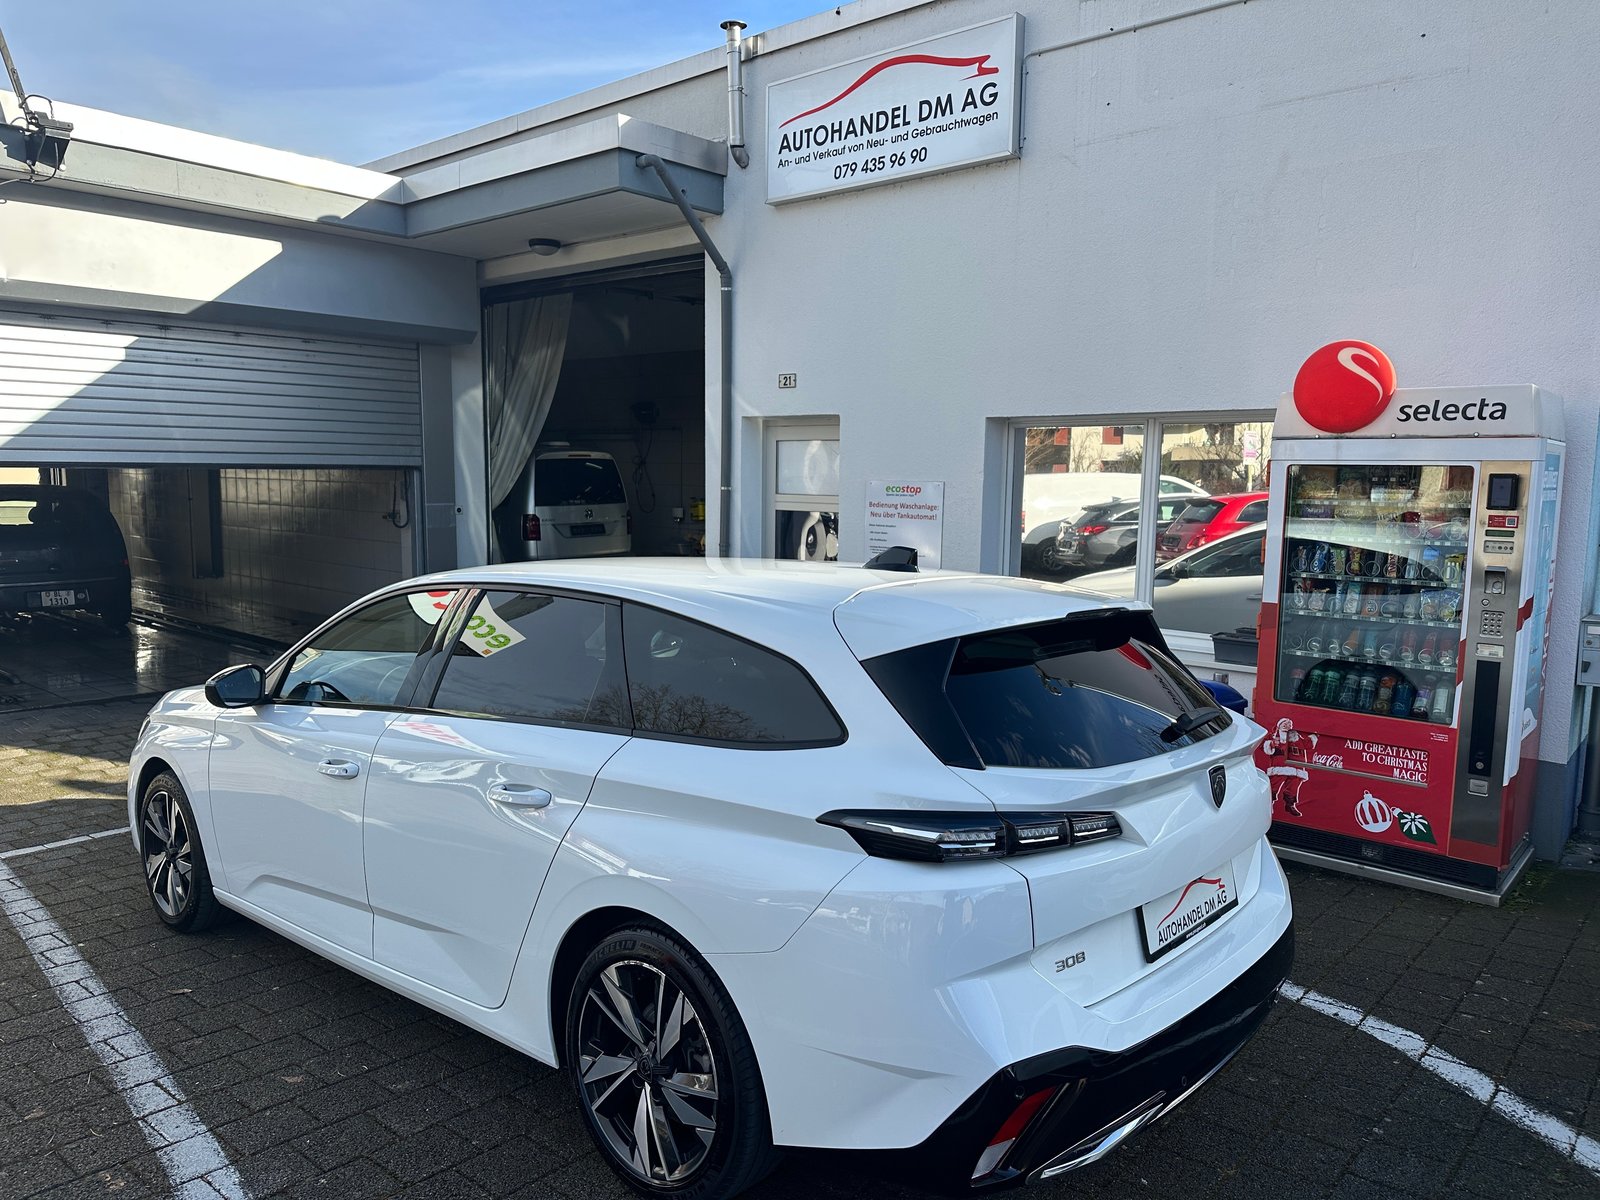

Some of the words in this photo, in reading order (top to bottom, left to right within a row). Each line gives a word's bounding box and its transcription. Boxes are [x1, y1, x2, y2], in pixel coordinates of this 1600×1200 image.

[778, 104, 911, 155] AUTOHANDEL
[918, 93, 954, 120] DM
[961, 82, 999, 112] AG
[777, 158, 793, 169] An-
[794, 154, 811, 165] und
[812, 144, 847, 161] Verkauf
[847, 143, 865, 153] von
[866, 136, 889, 149] Neu-
[890, 131, 909, 144] und
[911, 110, 999, 139] Gebrauchtwagen
[833, 164, 858, 181] 079
[860, 156, 886, 174] 435
[889, 152, 906, 169] 96
[909, 147, 928, 164] 90
[783, 375, 792, 387] 21
[1396, 398, 1507, 422] selecta
[885, 485, 921, 495] ecostop
[869, 501, 899, 510] Bedienung
[899, 502, 940, 512] Waschanlage:
[882, 511, 896, 519] über
[897, 512, 938, 521] Tankautomat!
[49, 597, 68, 605] 1310
[1344, 739, 1363, 751] ADD
[1365, 742, 1398, 757] GREAT
[1399, 748, 1428, 761] TASTE
[1312, 752, 1343, 769] Coca-Cola
[1362, 752, 1376, 764] TO
[1377, 754, 1428, 772] CHRISTMAS
[1393, 768, 1427, 783] MAGIC
[1158, 904, 1204, 946] AUTOHANDEL
[1204, 896, 1217, 915] DM
[1217, 889, 1227, 907] AG
[1055, 951, 1086, 973] 308
